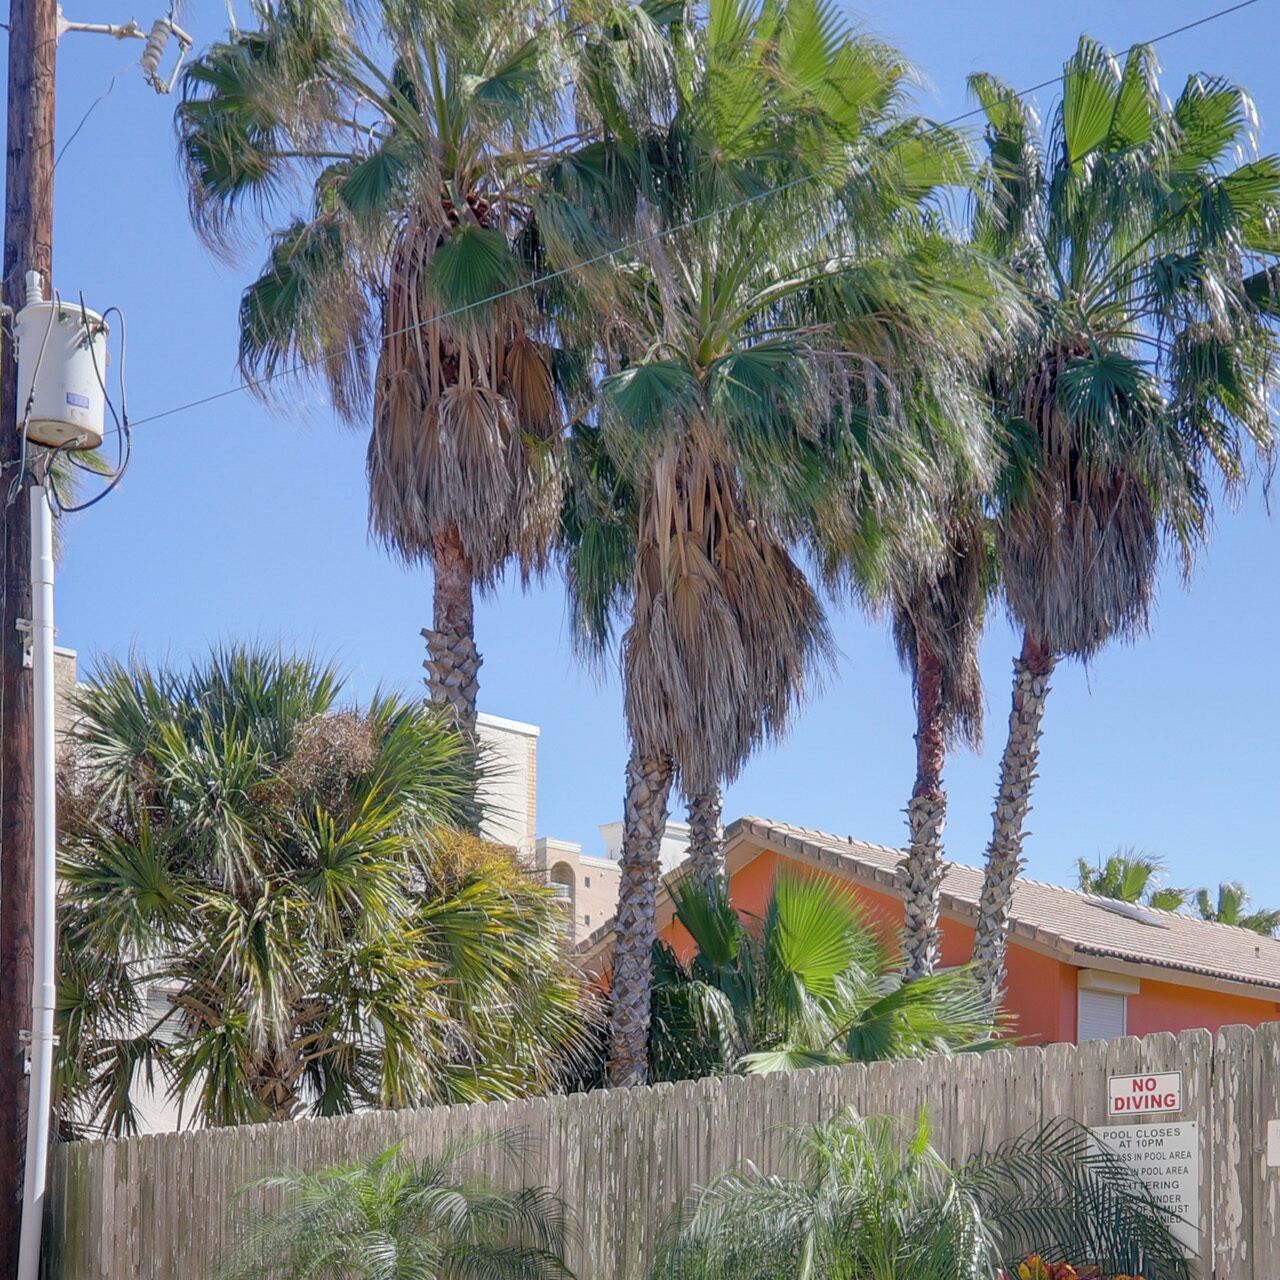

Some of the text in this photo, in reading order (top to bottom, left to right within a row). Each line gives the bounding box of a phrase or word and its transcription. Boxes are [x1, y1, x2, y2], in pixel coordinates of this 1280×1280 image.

[1132, 1078, 1156, 1092] NO
[1114, 1093, 1176, 1110] DIVING
[1103, 1128, 1181, 1140] POOL CLOSES
[1119, 1139, 1164, 1148] AT 10PM
[1134, 1152, 1142, 1161] IN
[1144, 1152, 1167, 1161] POOL
[1169, 1151, 1192, 1160] AREA
[1141, 1167, 1164, 1176] POOL
[1166, 1166, 1189, 1175] AREA
[1123, 1181, 1180, 1190] LITTERING
[1163, 1204, 1189, 1213] MUST
